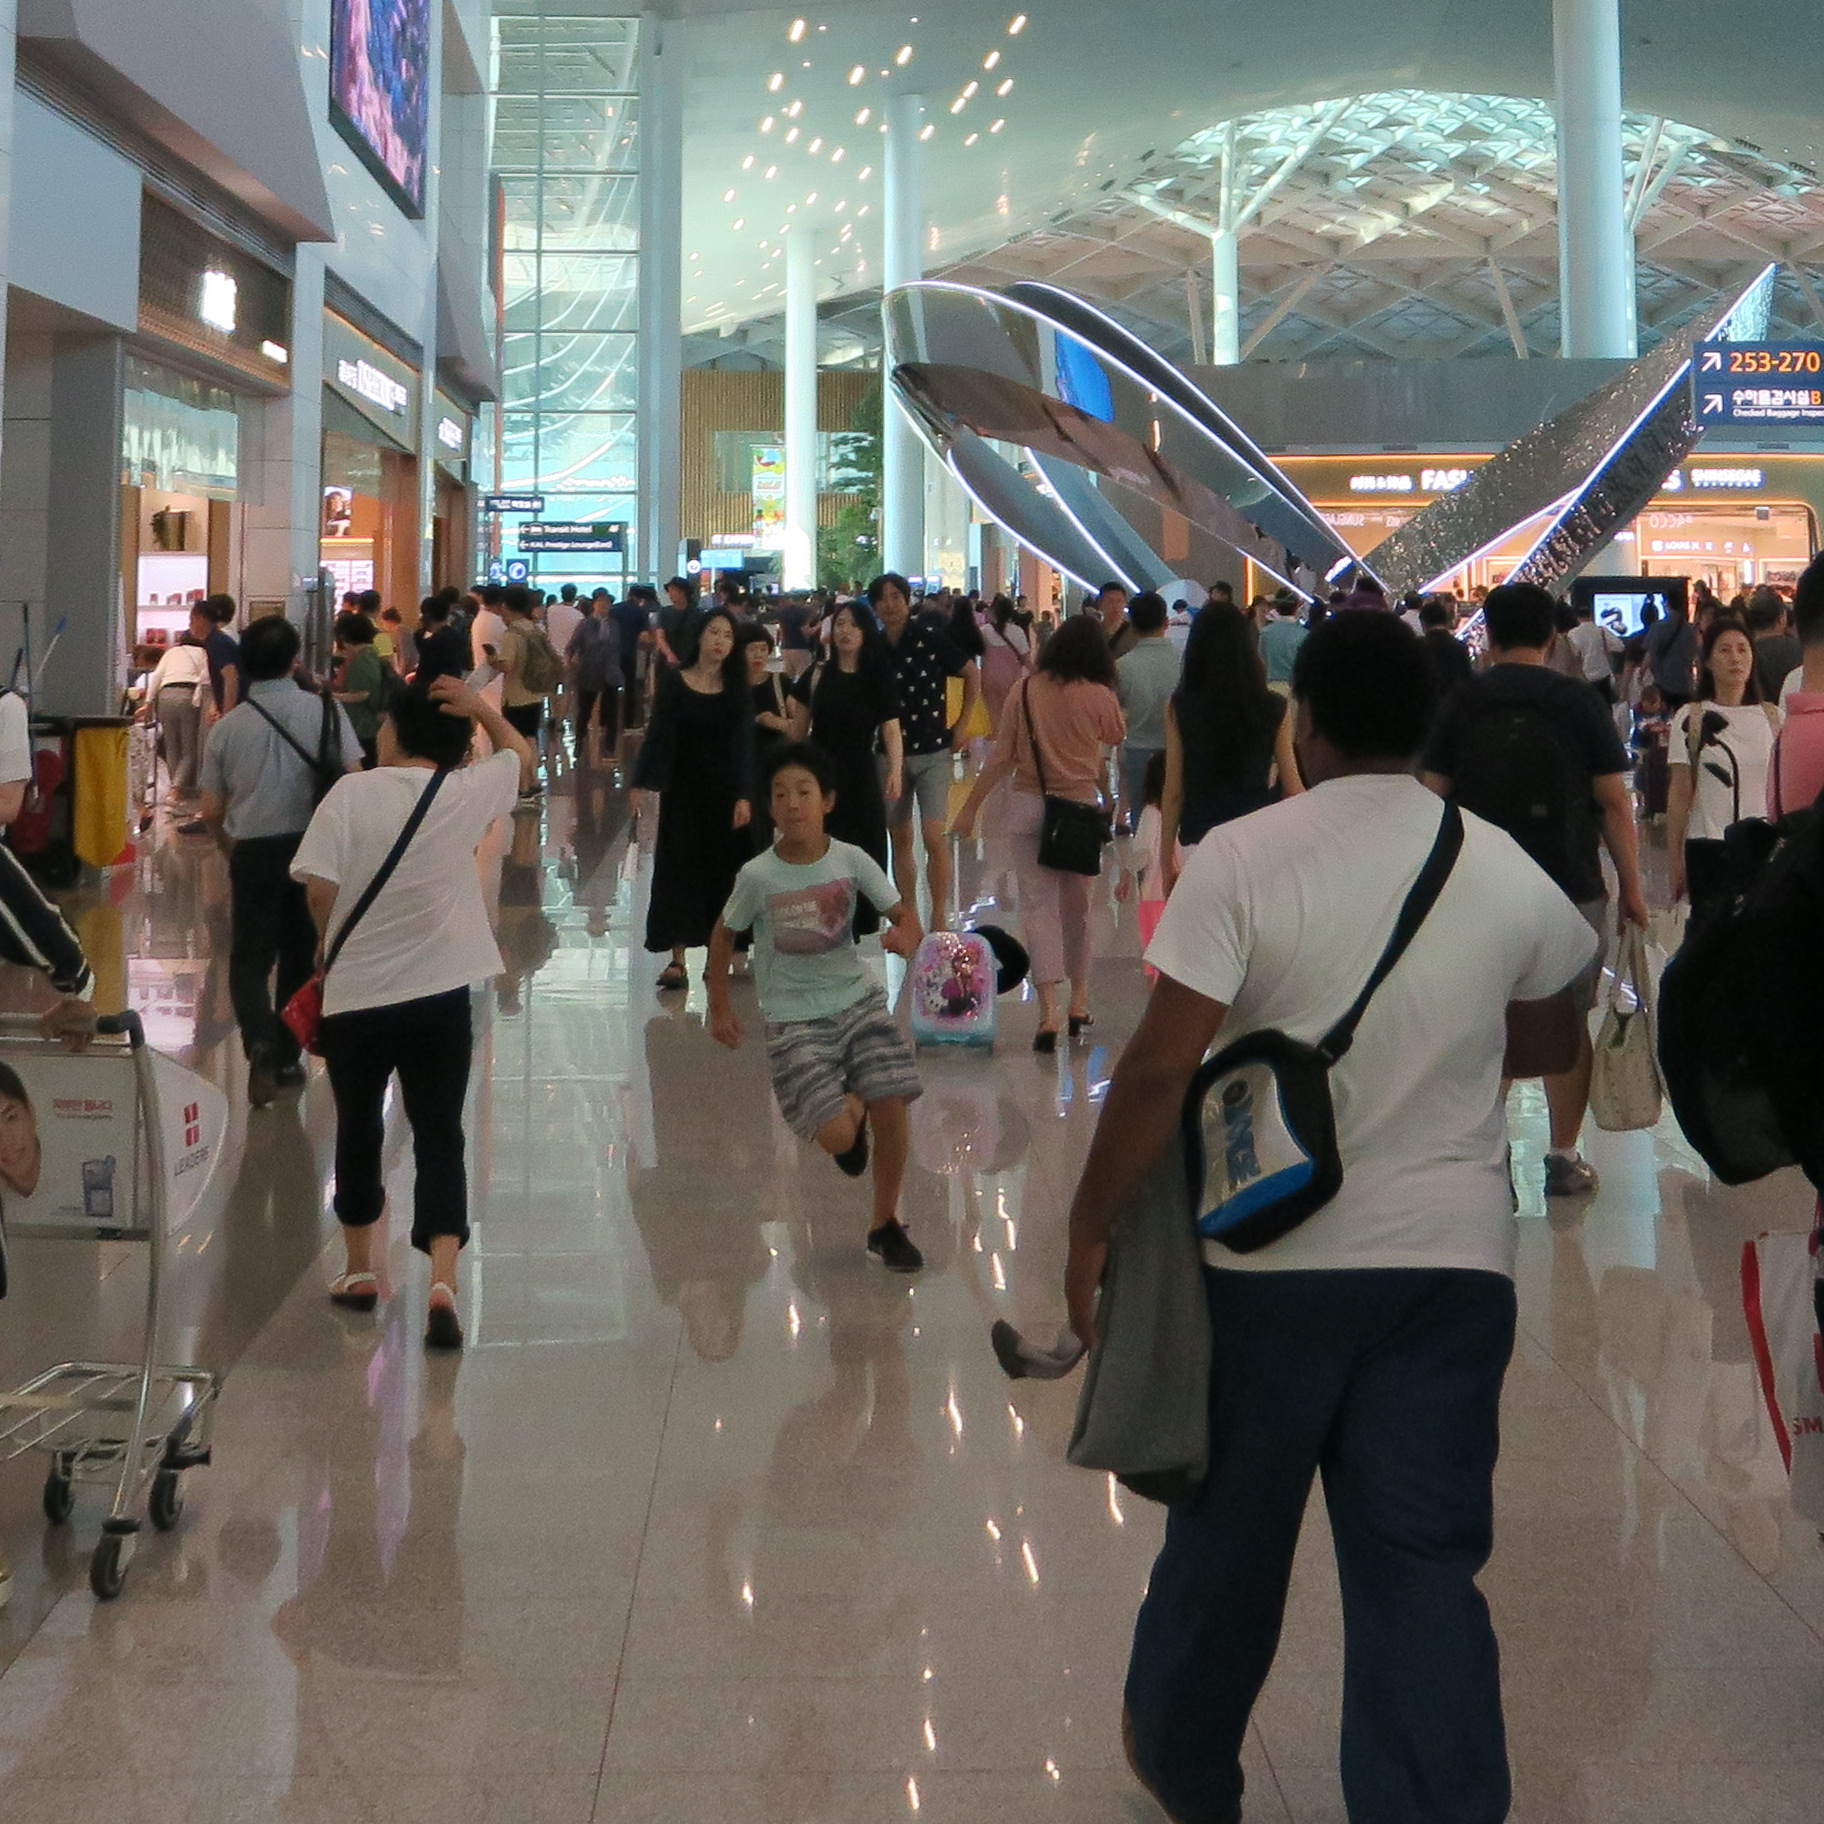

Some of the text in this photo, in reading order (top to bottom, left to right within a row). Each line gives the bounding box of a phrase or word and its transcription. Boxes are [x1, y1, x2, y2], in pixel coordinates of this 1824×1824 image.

[1729, 350, 1822, 374] 253-270
[1732, 408, 1766, 418] Checked
[1766, 408, 1801, 419] Baggage
[1792, 1416, 1824, 1435] SM
